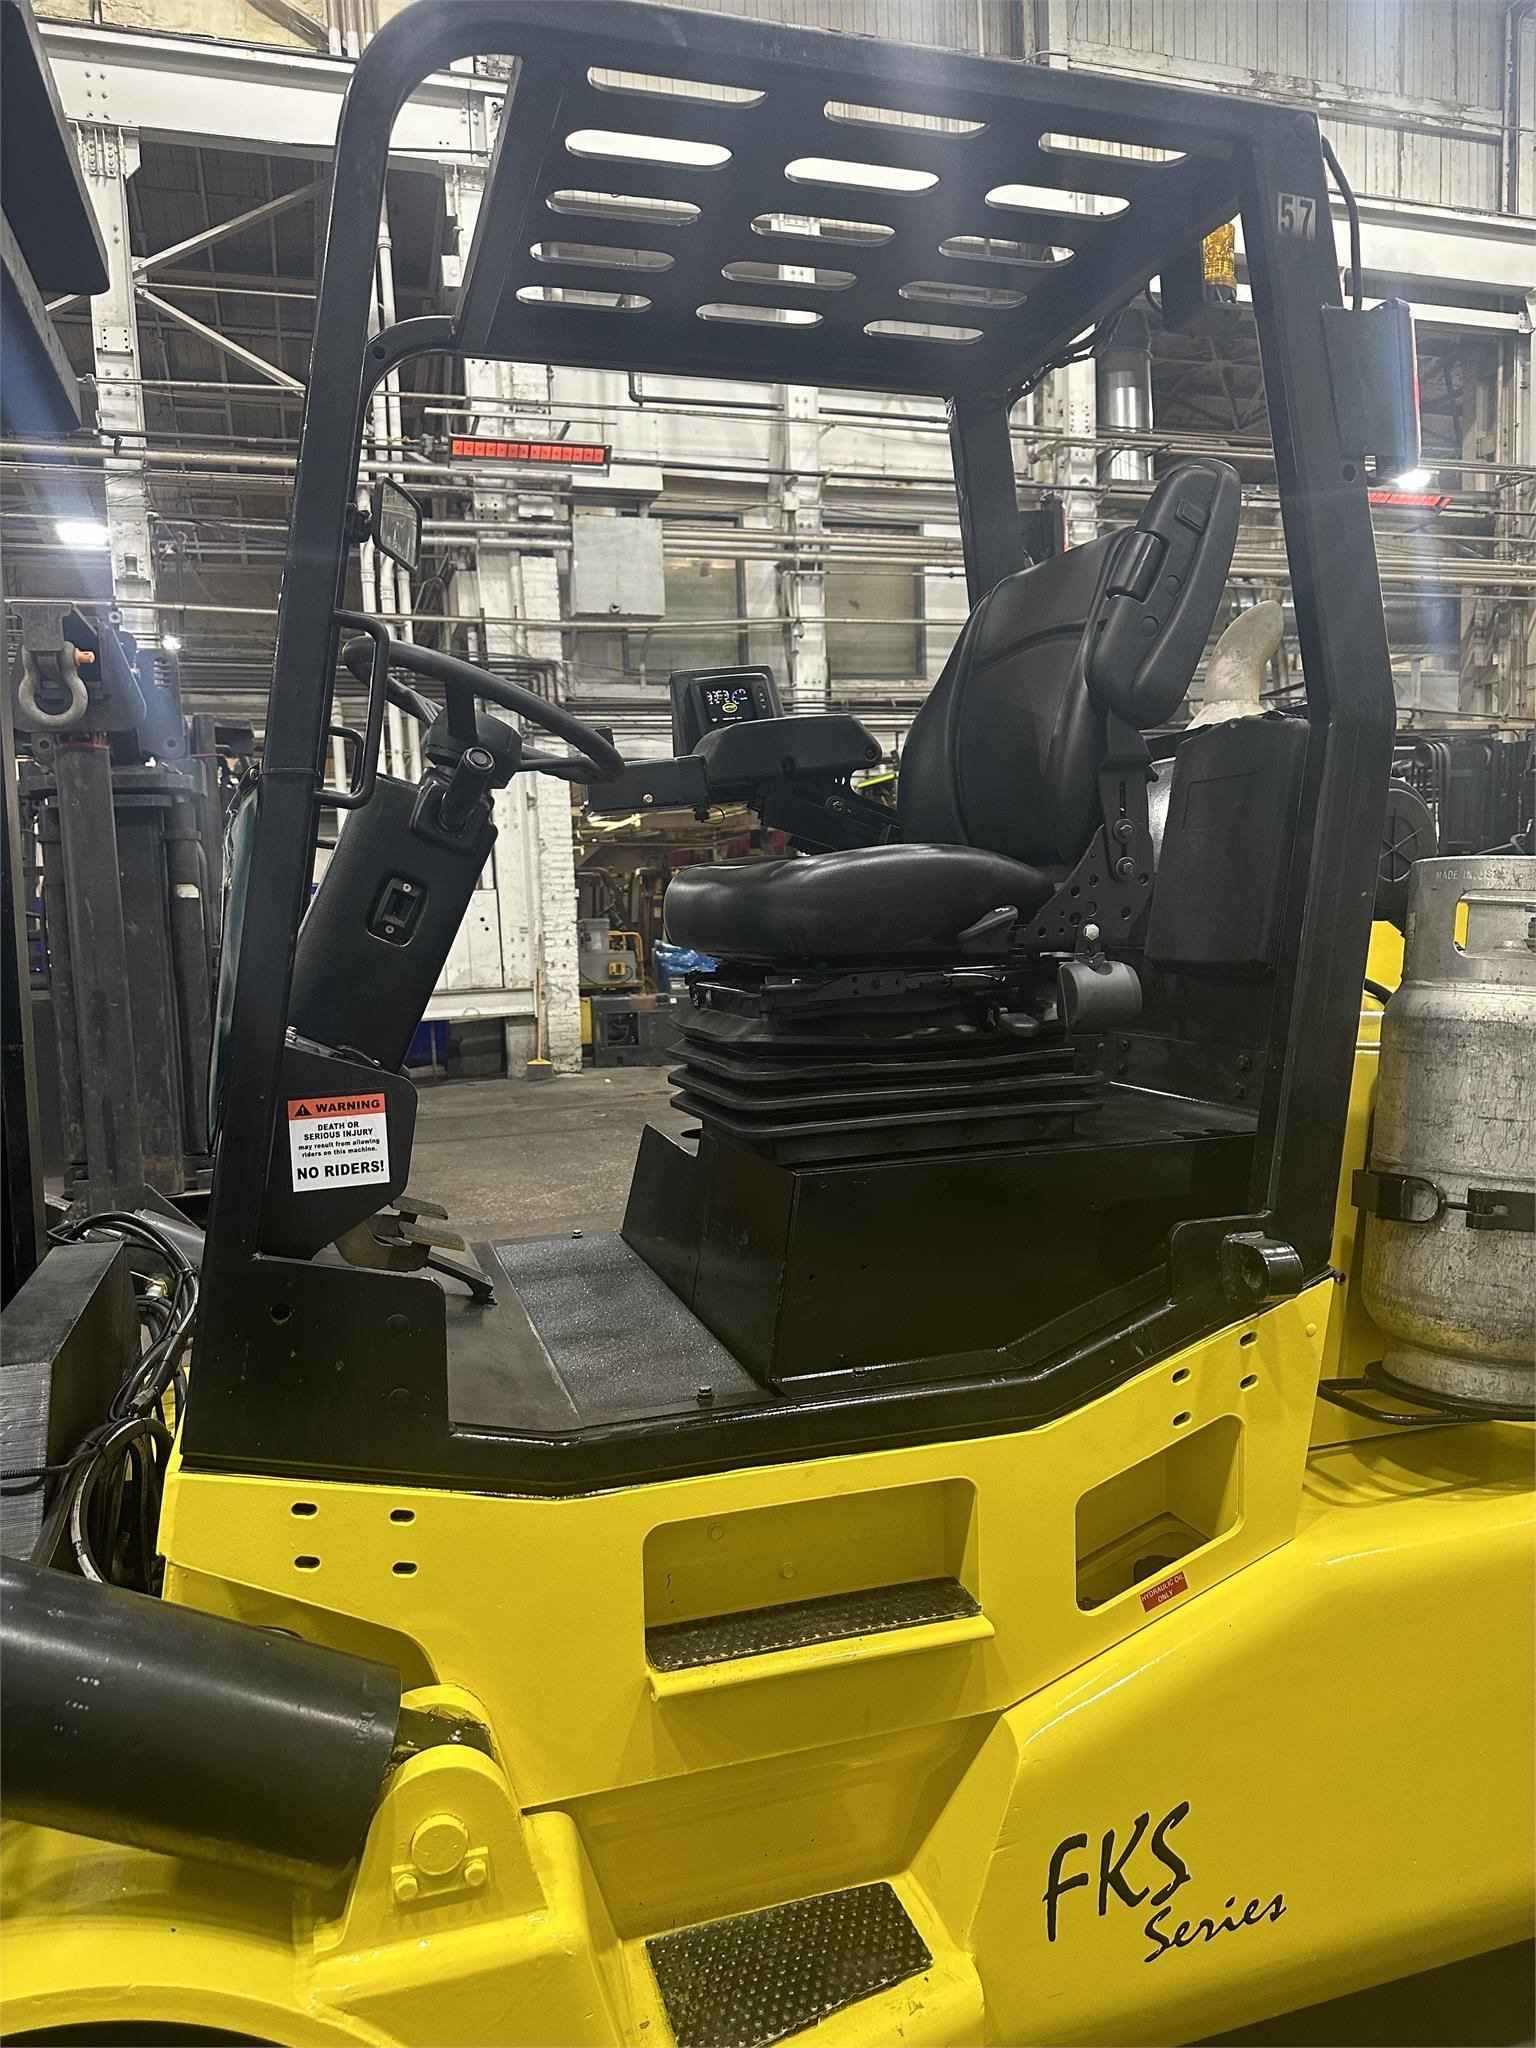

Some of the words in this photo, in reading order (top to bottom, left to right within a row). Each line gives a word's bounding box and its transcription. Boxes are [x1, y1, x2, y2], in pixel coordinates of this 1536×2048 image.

[1280, 195, 1313, 239] 57
[1436, 869, 1458, 881] MADE
[315, 1100, 380, 1113] WARNING
[317, 1122, 345, 1131] DEATH
[347, 1121, 359, 1129] OR
[303, 1131, 341, 1141] SERIOUS
[343, 1128, 373, 1138] INJURY
[314, 1140, 334, 1149] result
[335, 1139, 351, 1147] from
[352, 1138, 380, 1146] allowing
[301, 1150, 322, 1158] riders
[333, 1147, 346, 1155] this
[347, 1145, 378, 1154] machine.
[297, 1166, 319, 1180] NO
[324, 1160, 385, 1178] RIDERS!
[1157, 1589, 1174, 1603] ONLY
[1042, 1801, 1191, 1942] FKS
[1144, 1894, 1287, 1963] Series
